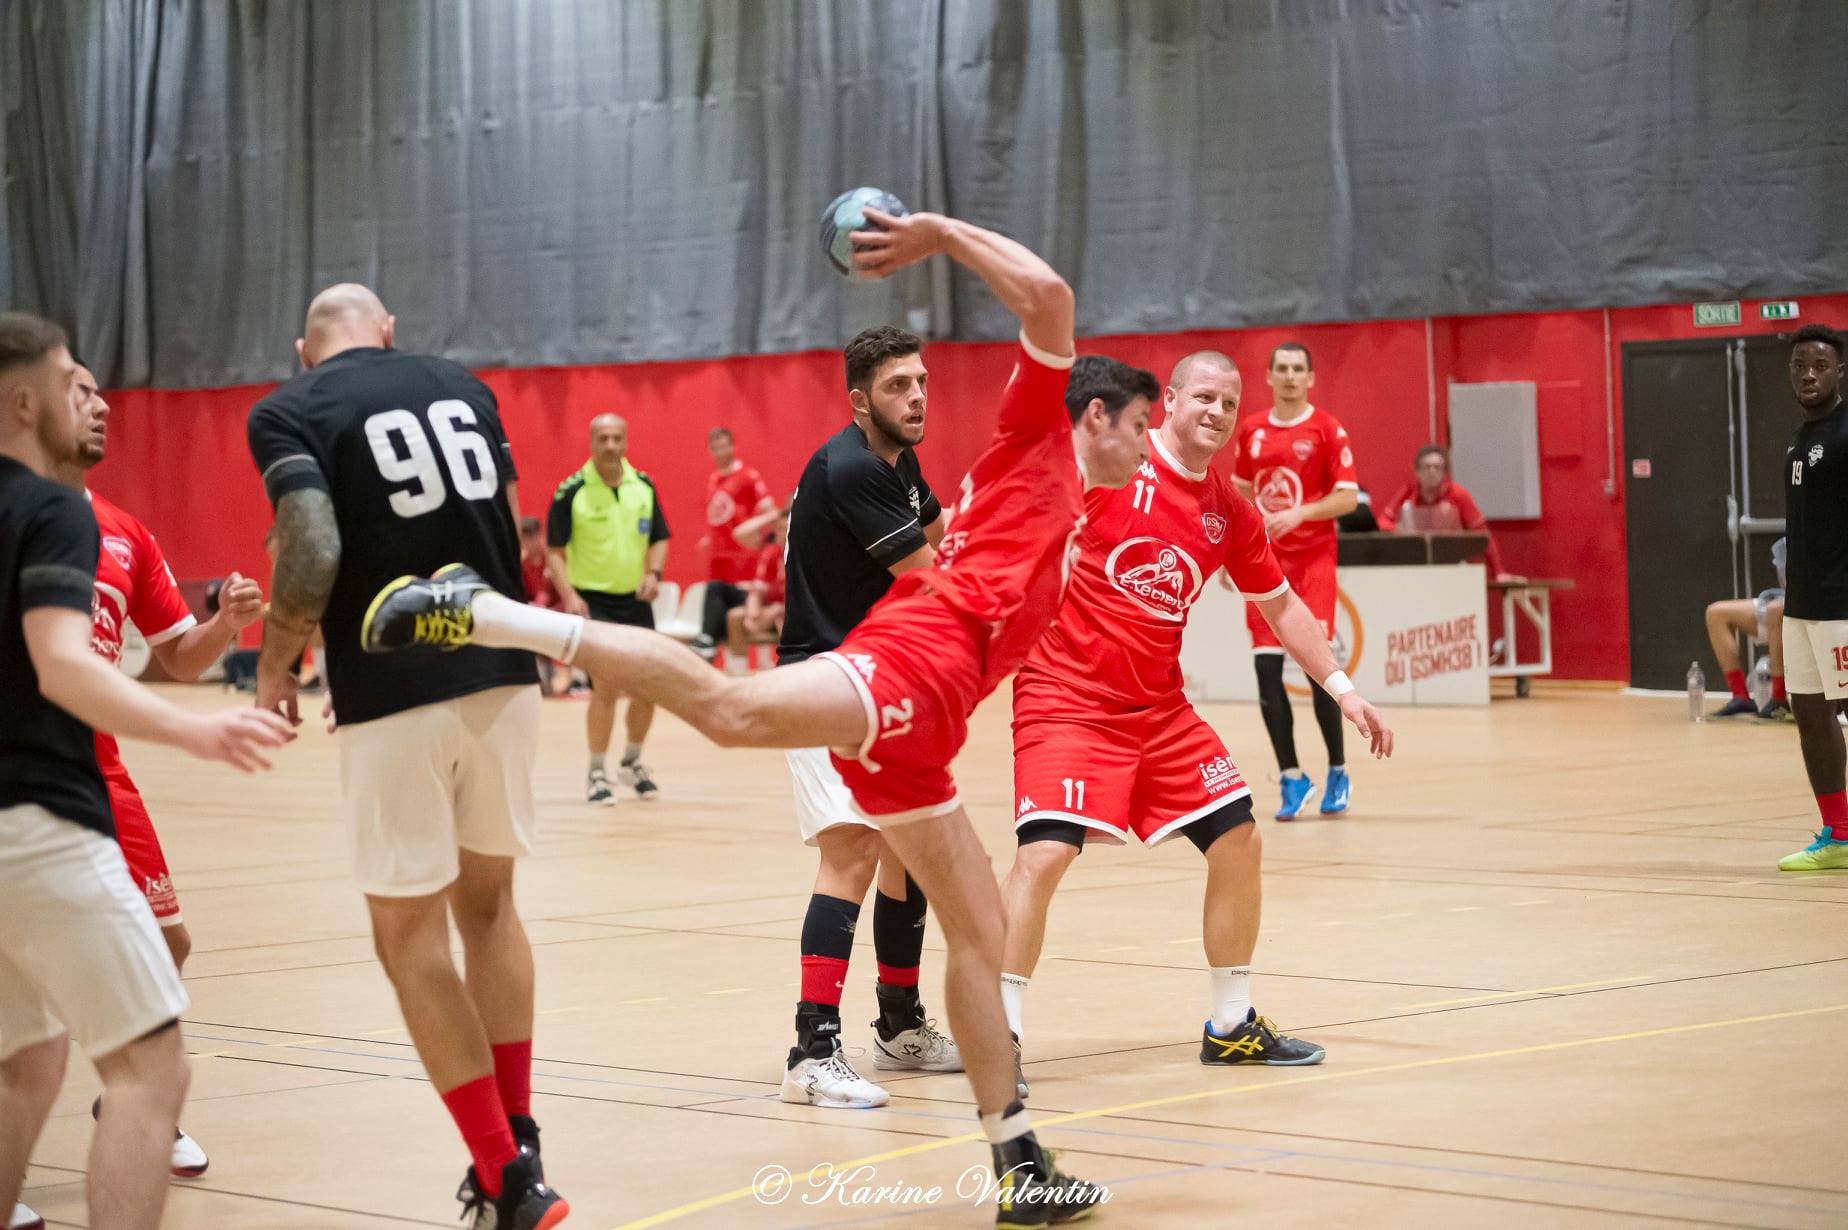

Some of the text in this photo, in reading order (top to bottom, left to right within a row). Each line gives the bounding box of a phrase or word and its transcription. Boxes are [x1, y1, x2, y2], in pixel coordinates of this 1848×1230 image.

[1698, 304, 1737, 325] SORTIE
[364, 399, 498, 518] 96
[1791, 460, 1803, 486] 19
[1132, 479, 1155, 514] 11
[1387, 614, 1476, 657] PARTENAIRE
[1386, 661, 1406, 686] DU
[1411, 643, 1472, 681] GSMH38
[880, 697, 914, 740] 21
[1062, 777, 1085, 811] 11
